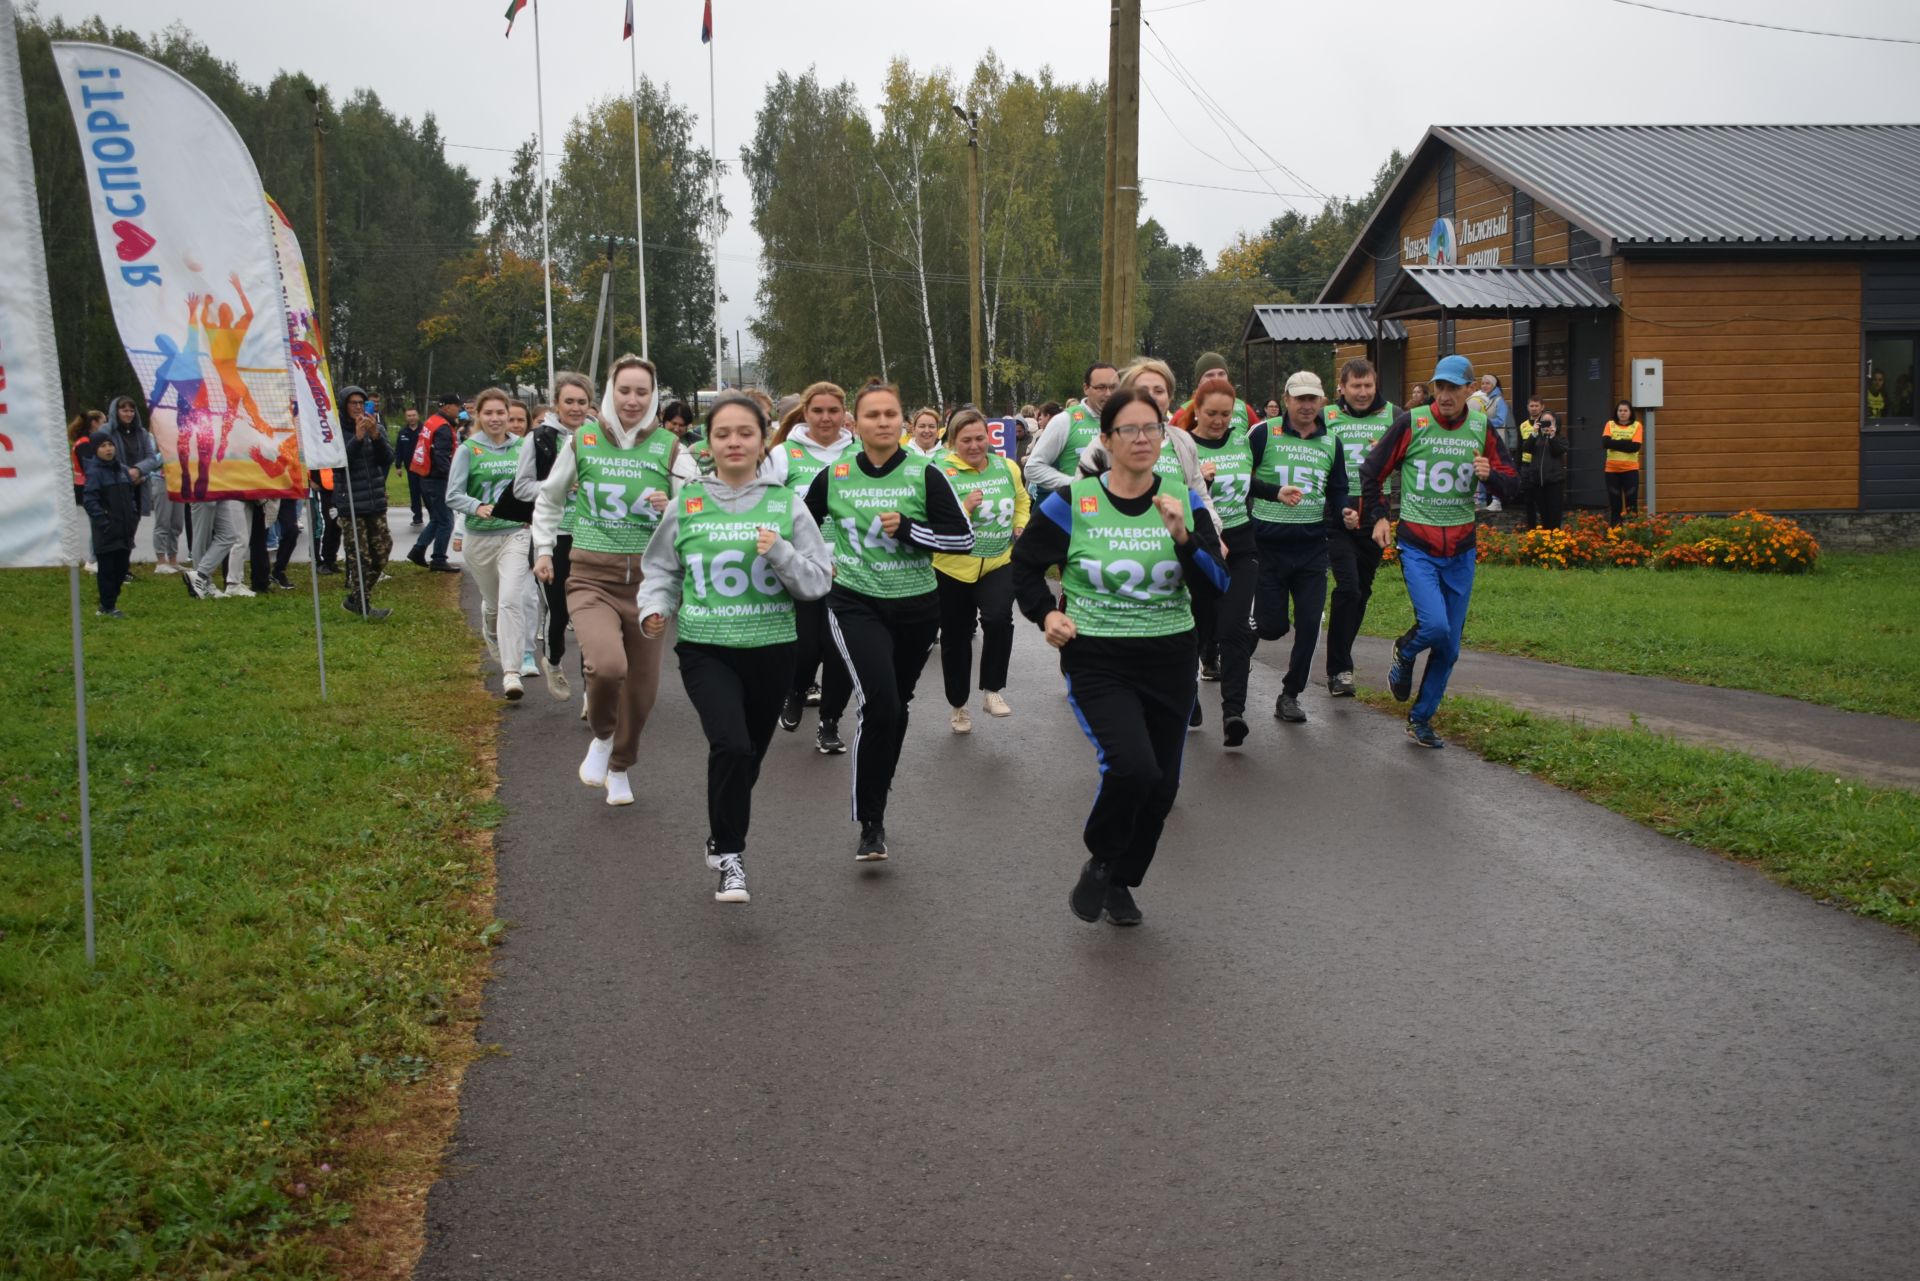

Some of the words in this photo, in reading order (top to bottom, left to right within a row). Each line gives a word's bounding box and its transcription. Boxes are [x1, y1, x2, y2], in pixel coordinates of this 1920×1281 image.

[78, 68, 146, 217] СПОРТ!
[1459, 205, 1509, 246] Лыжный
[120, 265, 162, 287] Я
[1343, 431, 1374, 439] РАЙОН
[1420, 437, 1479, 449] ТУКАЕВСКИЙ
[1432, 446, 1466, 456] РАЙОН
[585, 456, 658, 471] ТУКАЕВСКИЙ
[1287, 453, 1319, 464] РАЙОН
[601, 466, 642, 479] РАЙОН
[1153, 464, 1178, 474] АЙОН
[1274, 465, 1327, 496] 151
[1413, 459, 1475, 493] 168
[956, 476, 1009, 491] ТУКАЕВСКИЙ
[838, 486, 916, 498] ТУКАЕВСКИЙ
[582, 481, 662, 521] 134
[854, 498, 898, 508] РАЙОН
[708, 531, 760, 542] РАЙОН
[840, 514, 915, 554] 14
[1087, 527, 1171, 539] ТУКАЕВСКИ
[1108, 538, 1162, 551] РАЙОН
[685, 549, 784, 599] 166
[1079, 558, 1182, 600] 128
[718, 603, 760, 616] НОРМА
